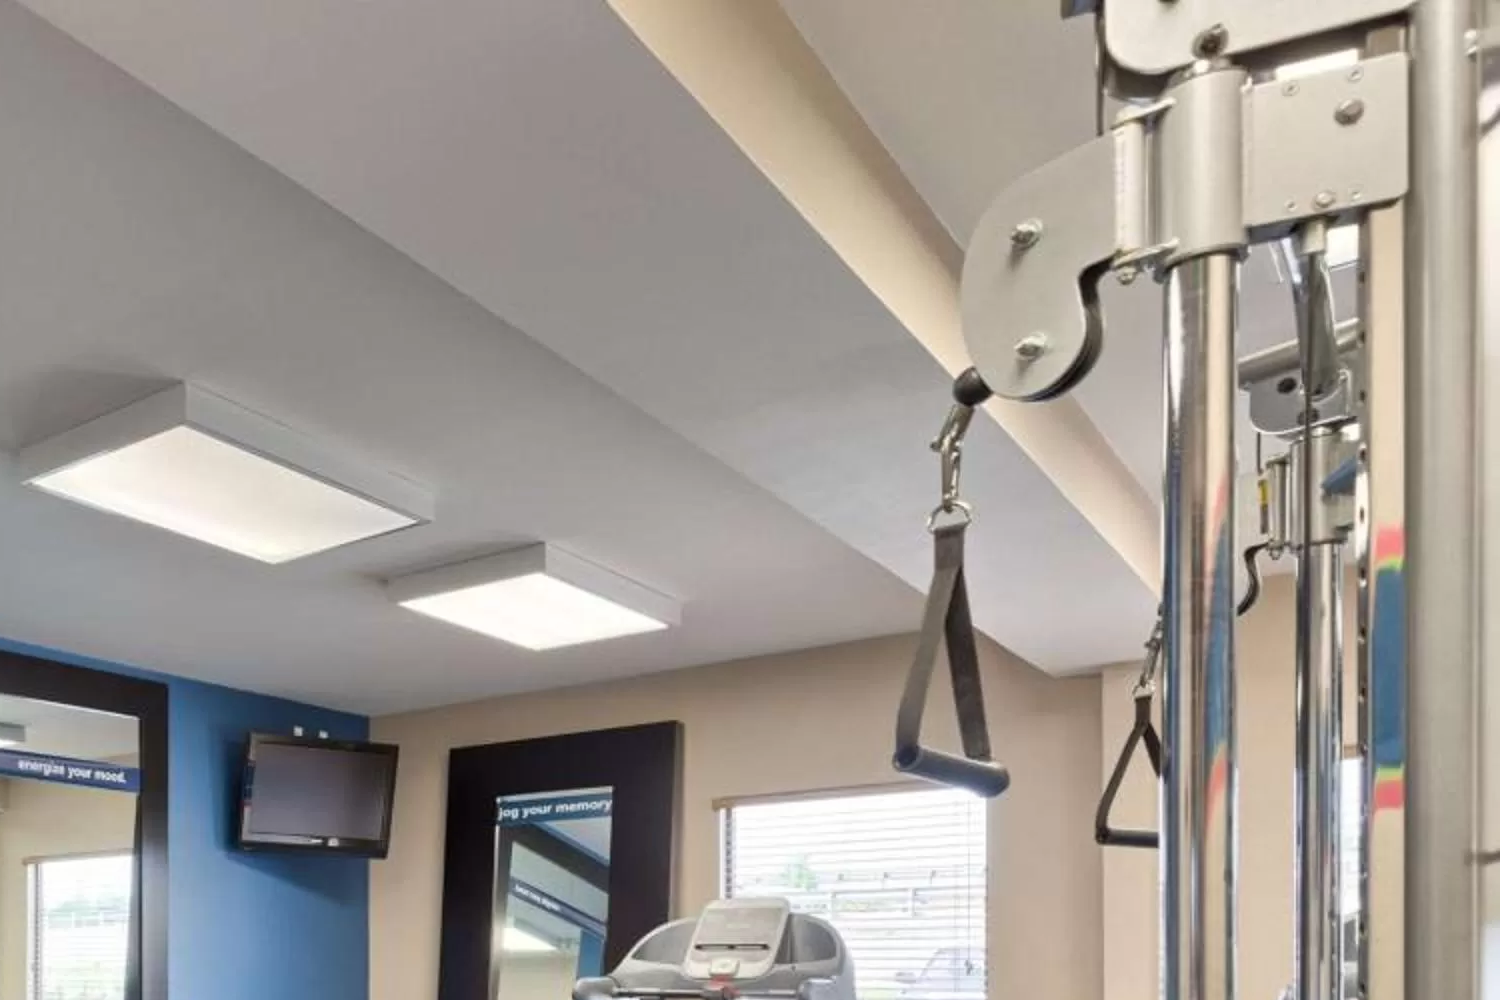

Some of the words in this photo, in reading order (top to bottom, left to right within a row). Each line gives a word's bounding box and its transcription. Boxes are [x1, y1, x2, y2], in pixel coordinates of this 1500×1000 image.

[67, 765, 93, 779] your
[498, 806, 520, 821] jog
[522, 803, 553, 819] your
[555, 798, 613, 814] memory
